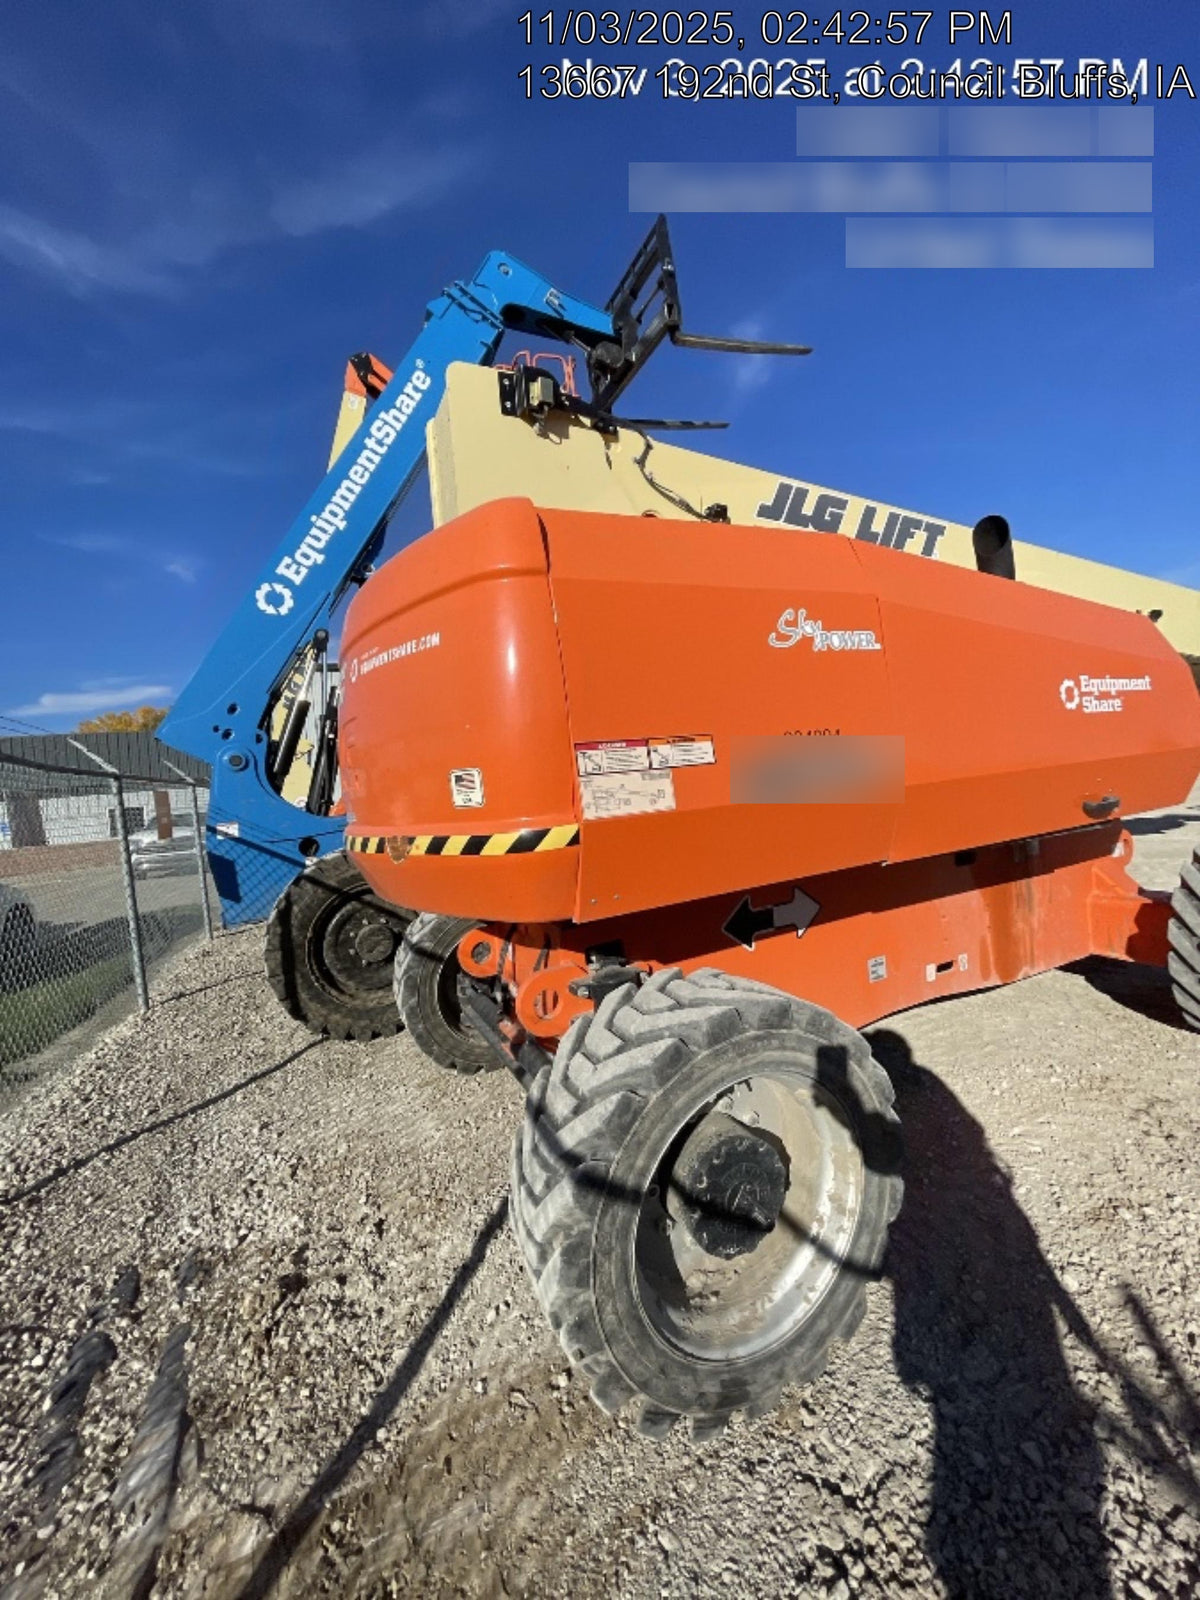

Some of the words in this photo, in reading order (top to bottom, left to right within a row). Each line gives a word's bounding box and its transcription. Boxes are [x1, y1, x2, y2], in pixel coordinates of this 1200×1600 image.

[275, 369, 431, 585] EquipmentShare
[756, 481, 849, 534] JLG
[855, 504, 947, 557] LIFT
[768, 608, 822, 651] Sky
[818, 630, 881, 651] POWER
[1079, 675, 1152, 695] Equipment
[1082, 696, 1122, 713] Share
